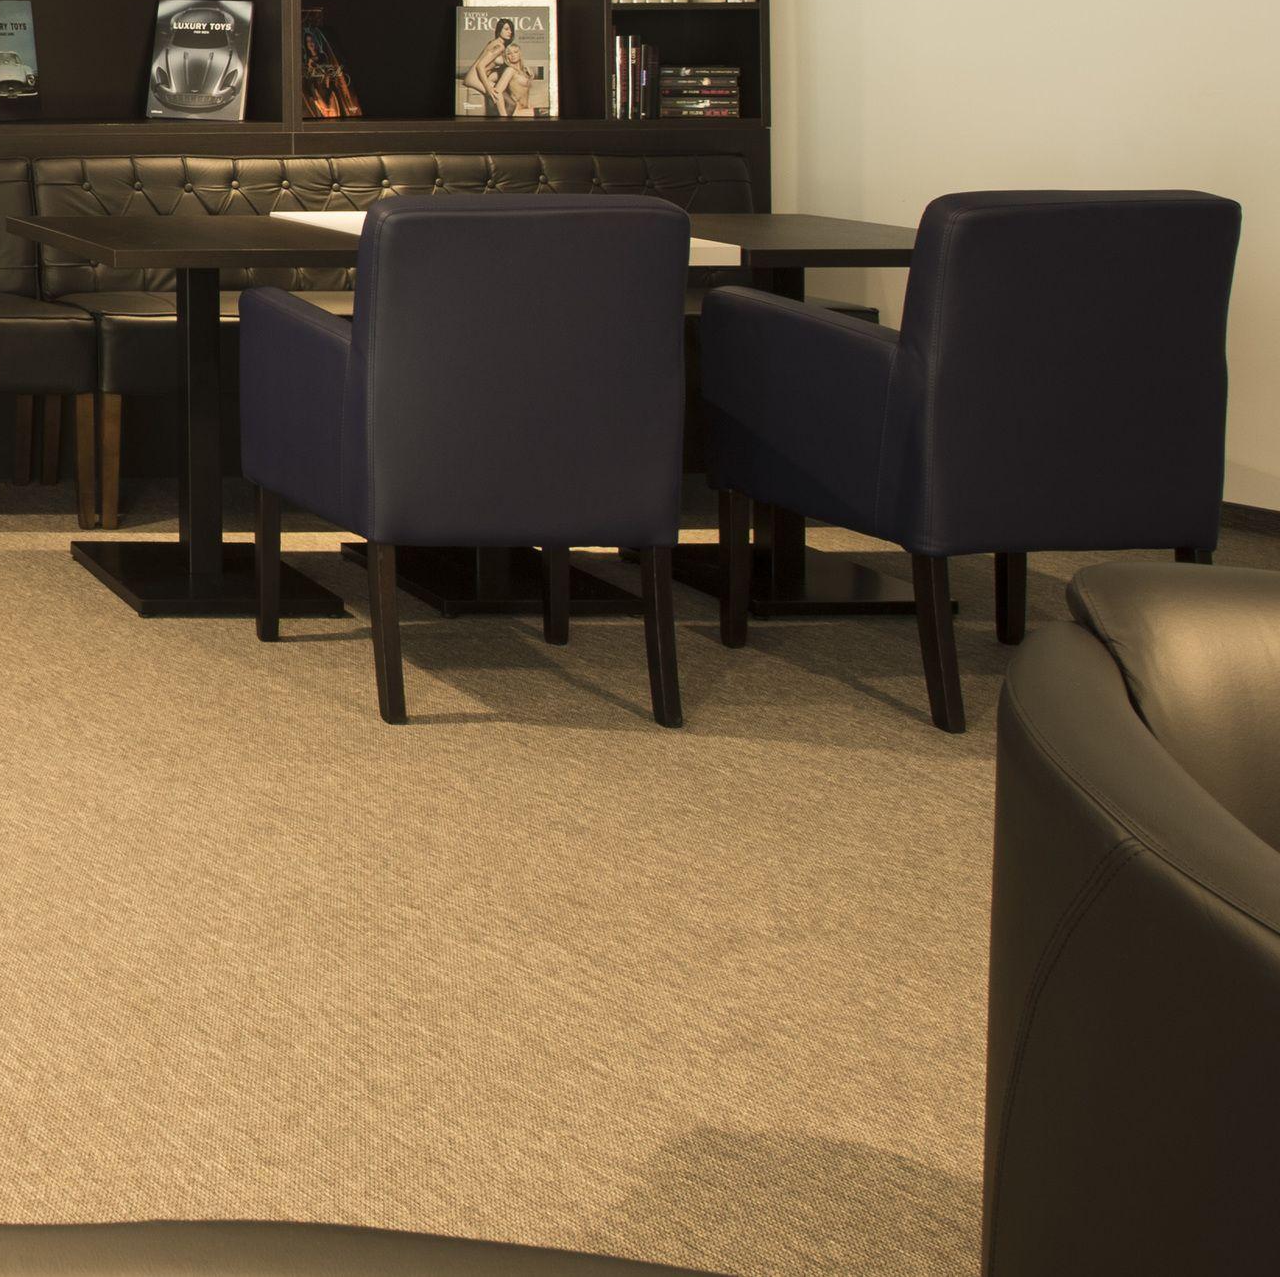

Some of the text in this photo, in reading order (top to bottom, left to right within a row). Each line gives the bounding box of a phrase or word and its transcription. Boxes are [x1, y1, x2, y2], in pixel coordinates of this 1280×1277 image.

[10, 22, 27, 31] TOYS
[173, 22, 232, 31] LUXURY TOYS
[464, 16, 544, 31] EROICA
